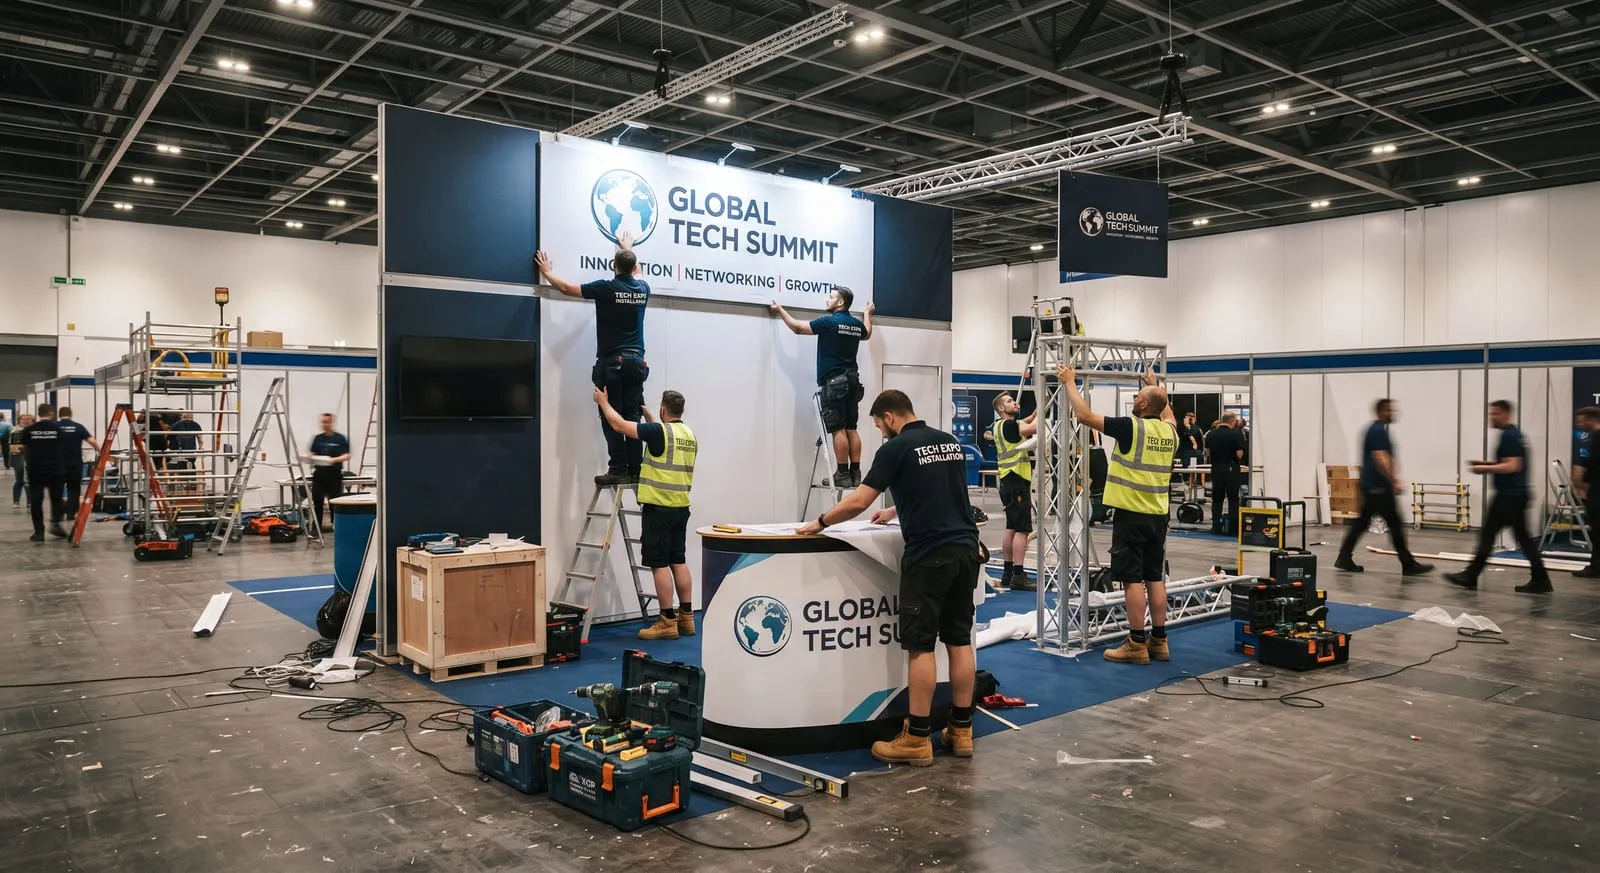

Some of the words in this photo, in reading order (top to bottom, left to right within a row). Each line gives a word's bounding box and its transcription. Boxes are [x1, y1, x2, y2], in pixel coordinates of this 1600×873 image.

[668, 186, 776, 226] GLOBAL
[1106, 211, 1139, 223] GLOBAL
[1106, 221, 1128, 231] TECH
[1128, 223, 1159, 235] SUMMIT
[668, 218, 739, 252] TECH
[746, 230, 838, 264] SUMMIT
[685, 267, 775, 289] NETWORKING
[914, 445, 939, 457] TECH
[940, 443, 961, 453] EXPO
[918, 453, 964, 466] INSTALLATION
[803, 595, 901, 623] GLOBAL
[803, 625, 871, 651] TECH
